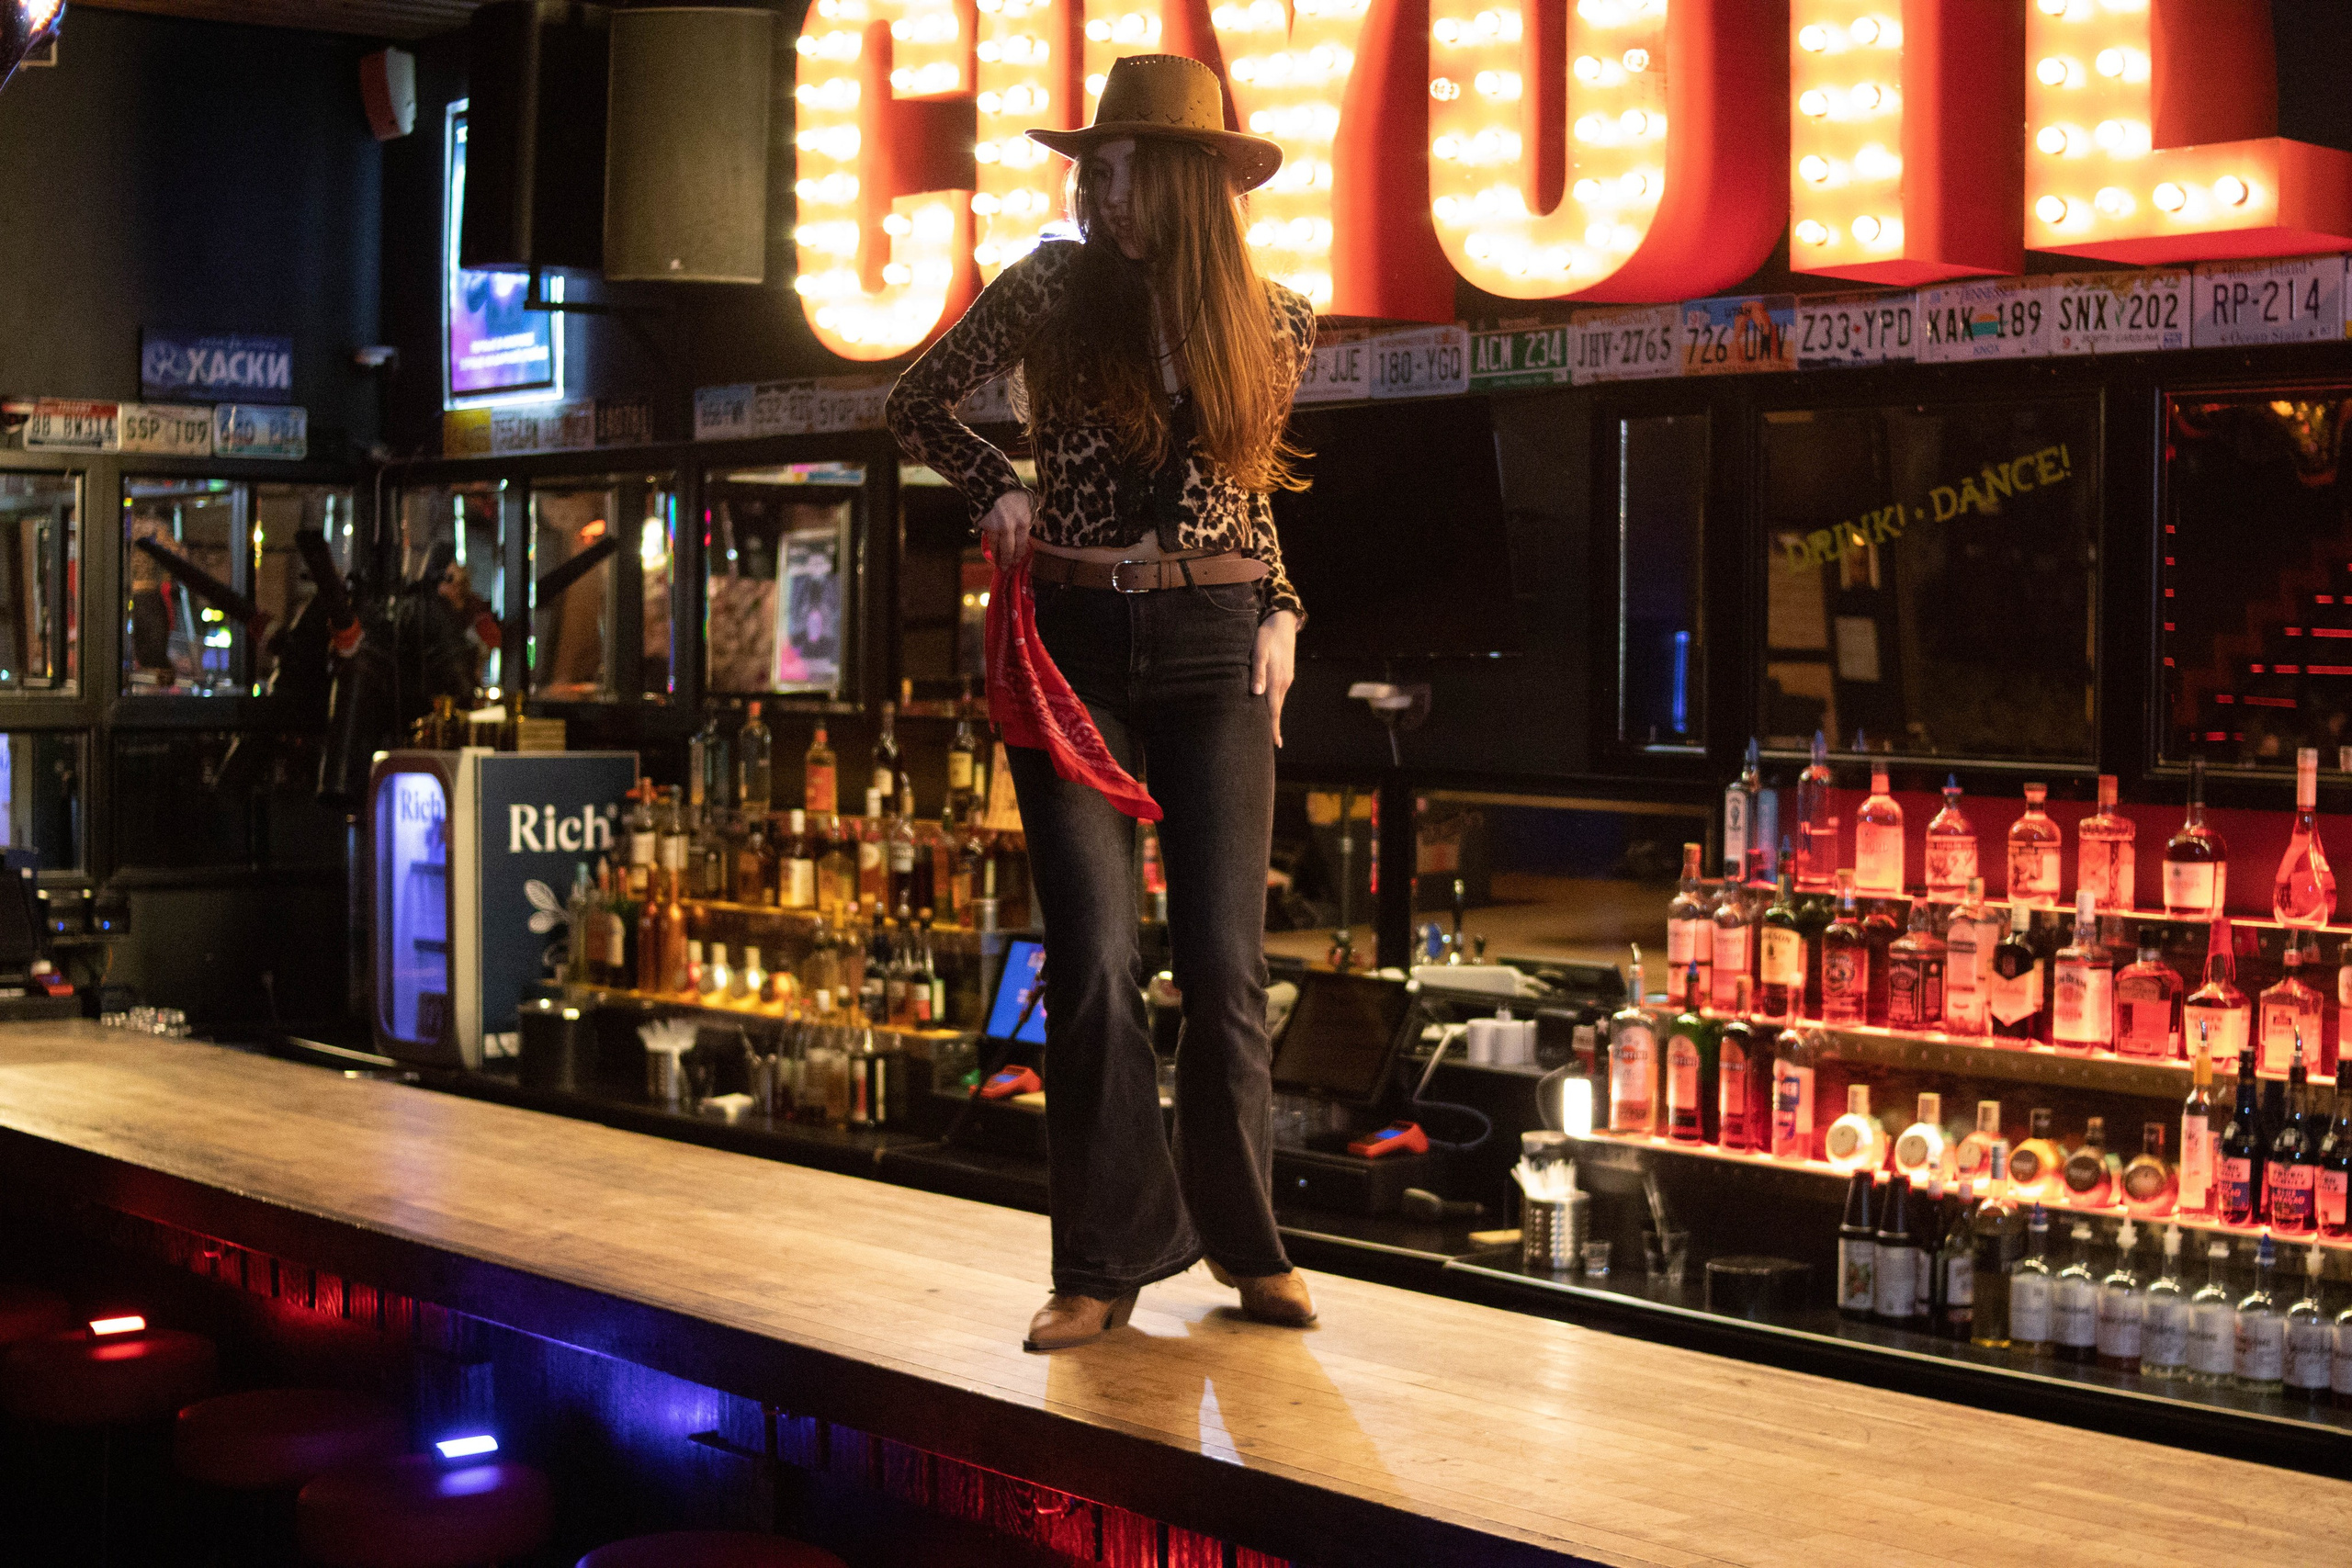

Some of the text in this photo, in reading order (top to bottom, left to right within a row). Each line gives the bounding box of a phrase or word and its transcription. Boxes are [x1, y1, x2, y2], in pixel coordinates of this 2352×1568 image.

[1996, 299, 2041, 339] 189
[2059, 292, 2178, 332] SNX 202
[2212, 276, 2320, 326] RP-214
[1524, 330, 1562, 367] 234
[1687, 325, 1727, 365] 726
[1801, 308, 1912, 353] Z33 YPD
[187, 346, 289, 389] ХАСКИ
[1929, 444, 2072, 523] DANCE!
[509, 803, 615, 853] Rich
